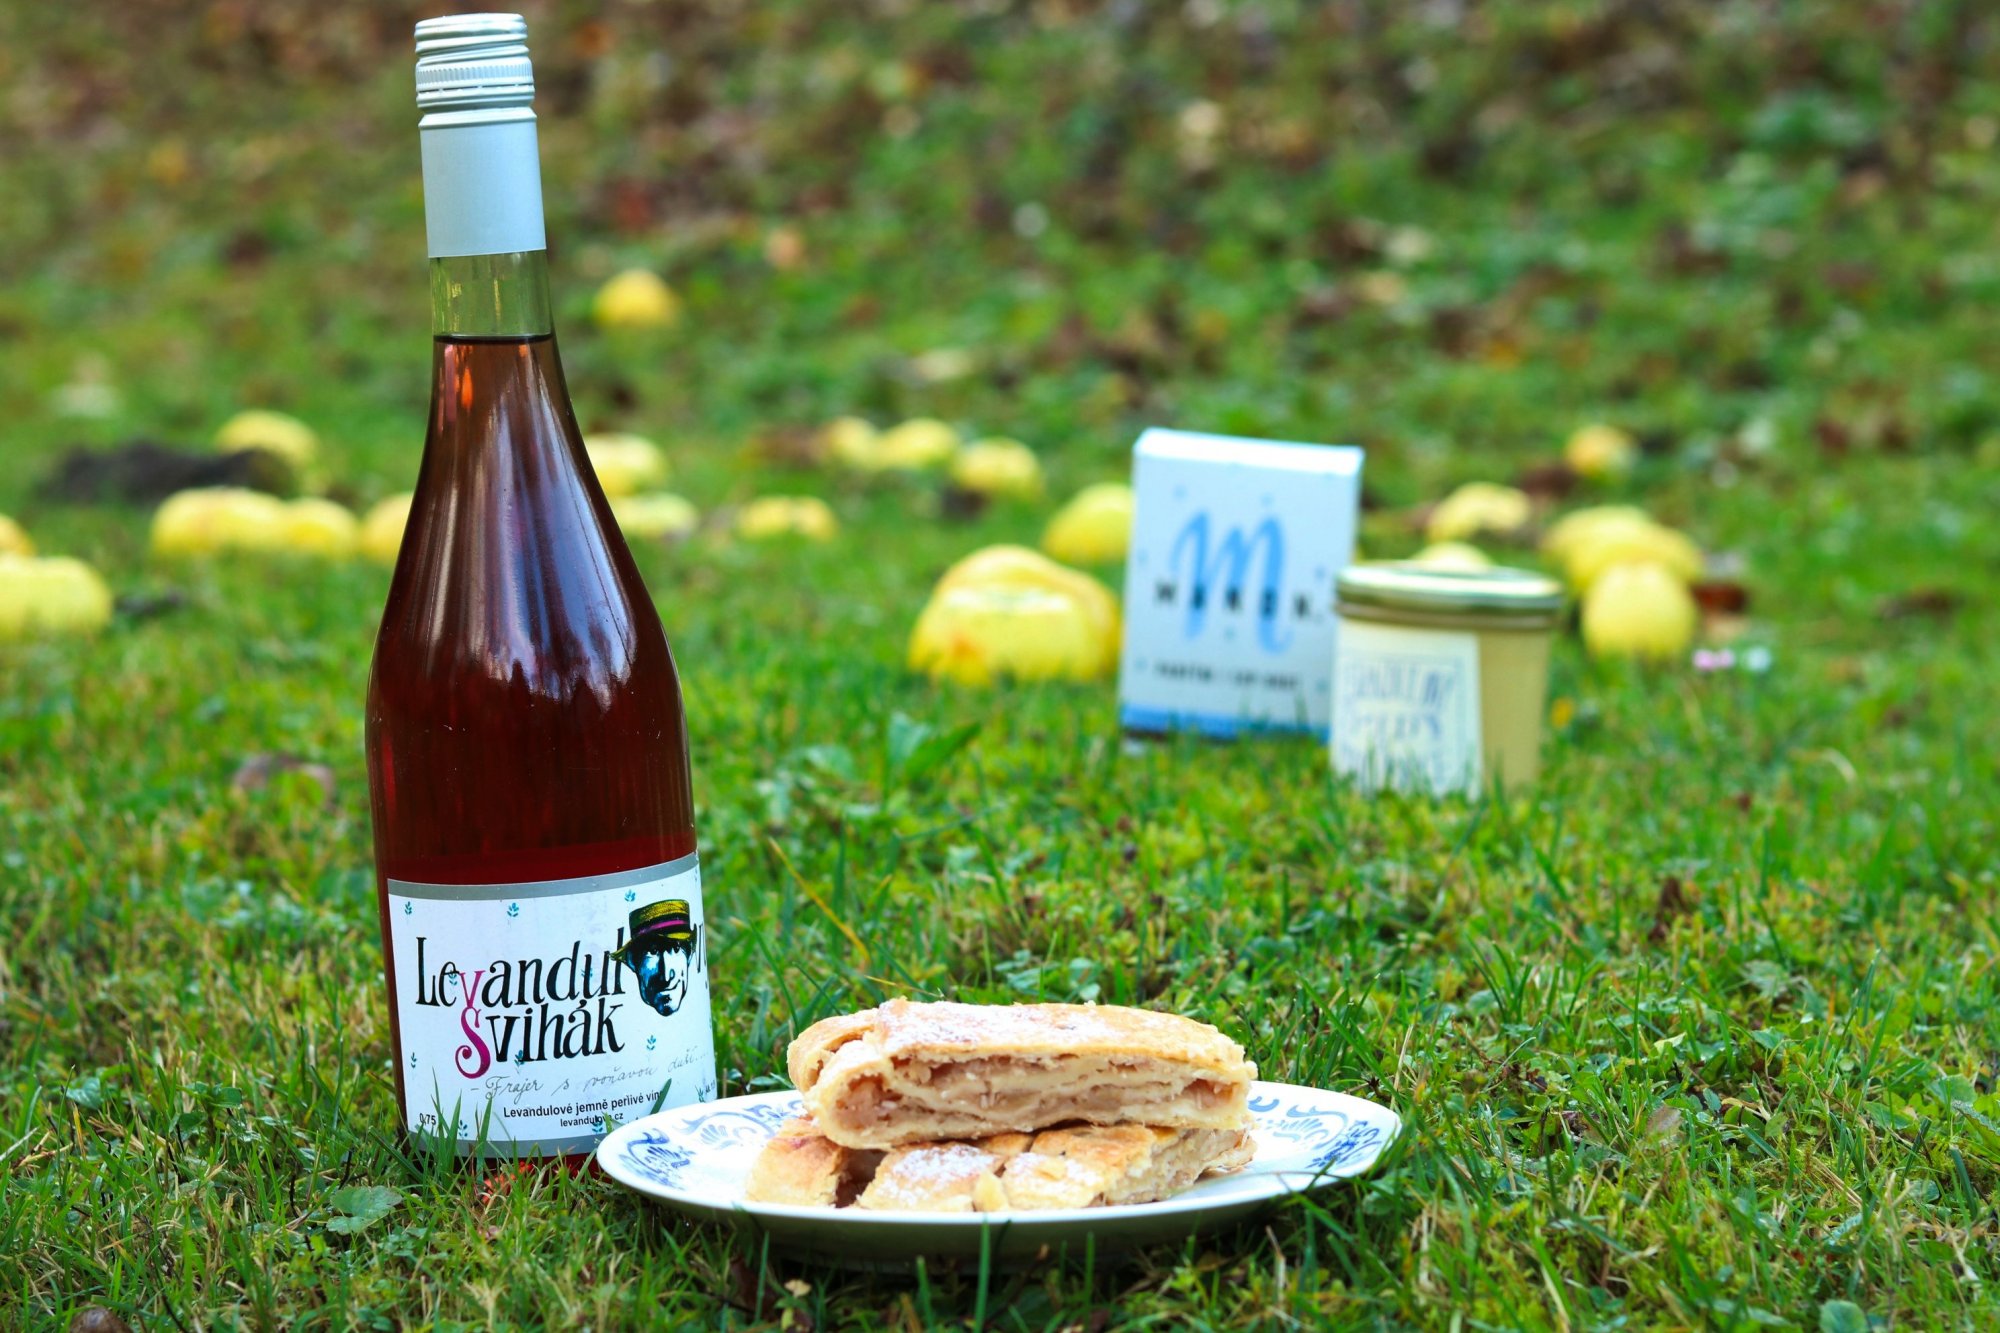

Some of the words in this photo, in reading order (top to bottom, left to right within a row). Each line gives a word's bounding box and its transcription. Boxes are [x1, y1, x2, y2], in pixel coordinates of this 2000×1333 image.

[485, 1075, 544, 1105] Frajer
[503, 1104, 573, 1118] Levandulové
[575, 1098, 608, 1116] jemně
[611, 1092, 644, 1111] perlivé
[645, 1088, 664, 1102] vín
